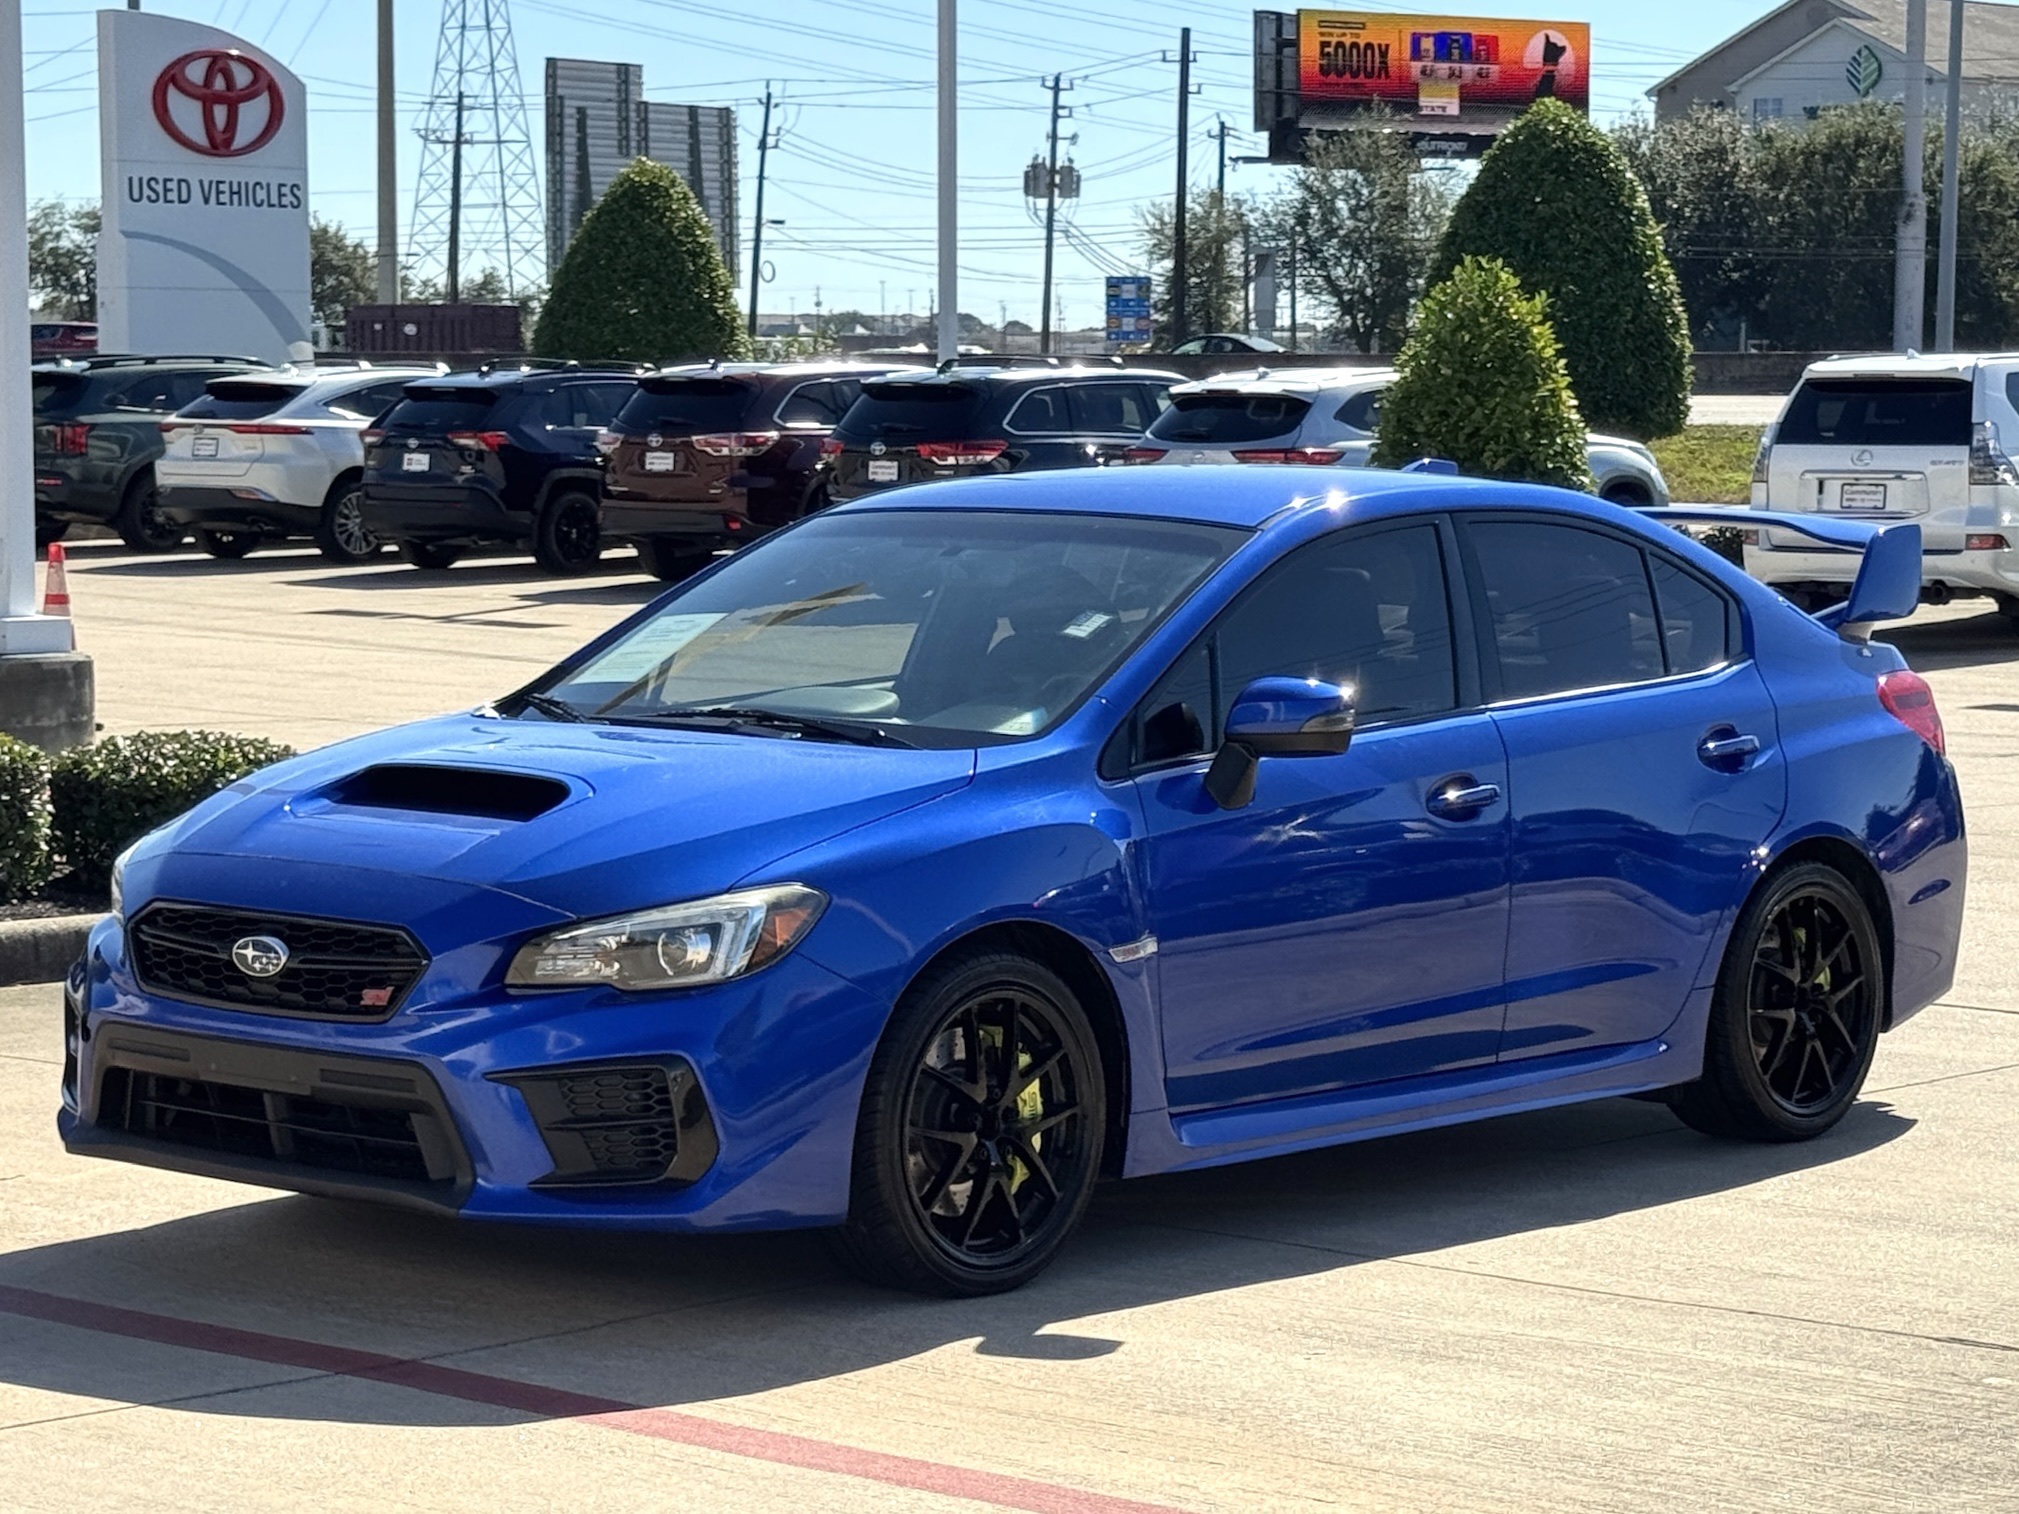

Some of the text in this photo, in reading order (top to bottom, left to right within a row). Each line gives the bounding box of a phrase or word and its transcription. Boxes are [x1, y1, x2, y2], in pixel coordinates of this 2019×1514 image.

[1319, 40, 1390, 79] 5000X
[127, 176, 302, 210] USED VEHICLES
